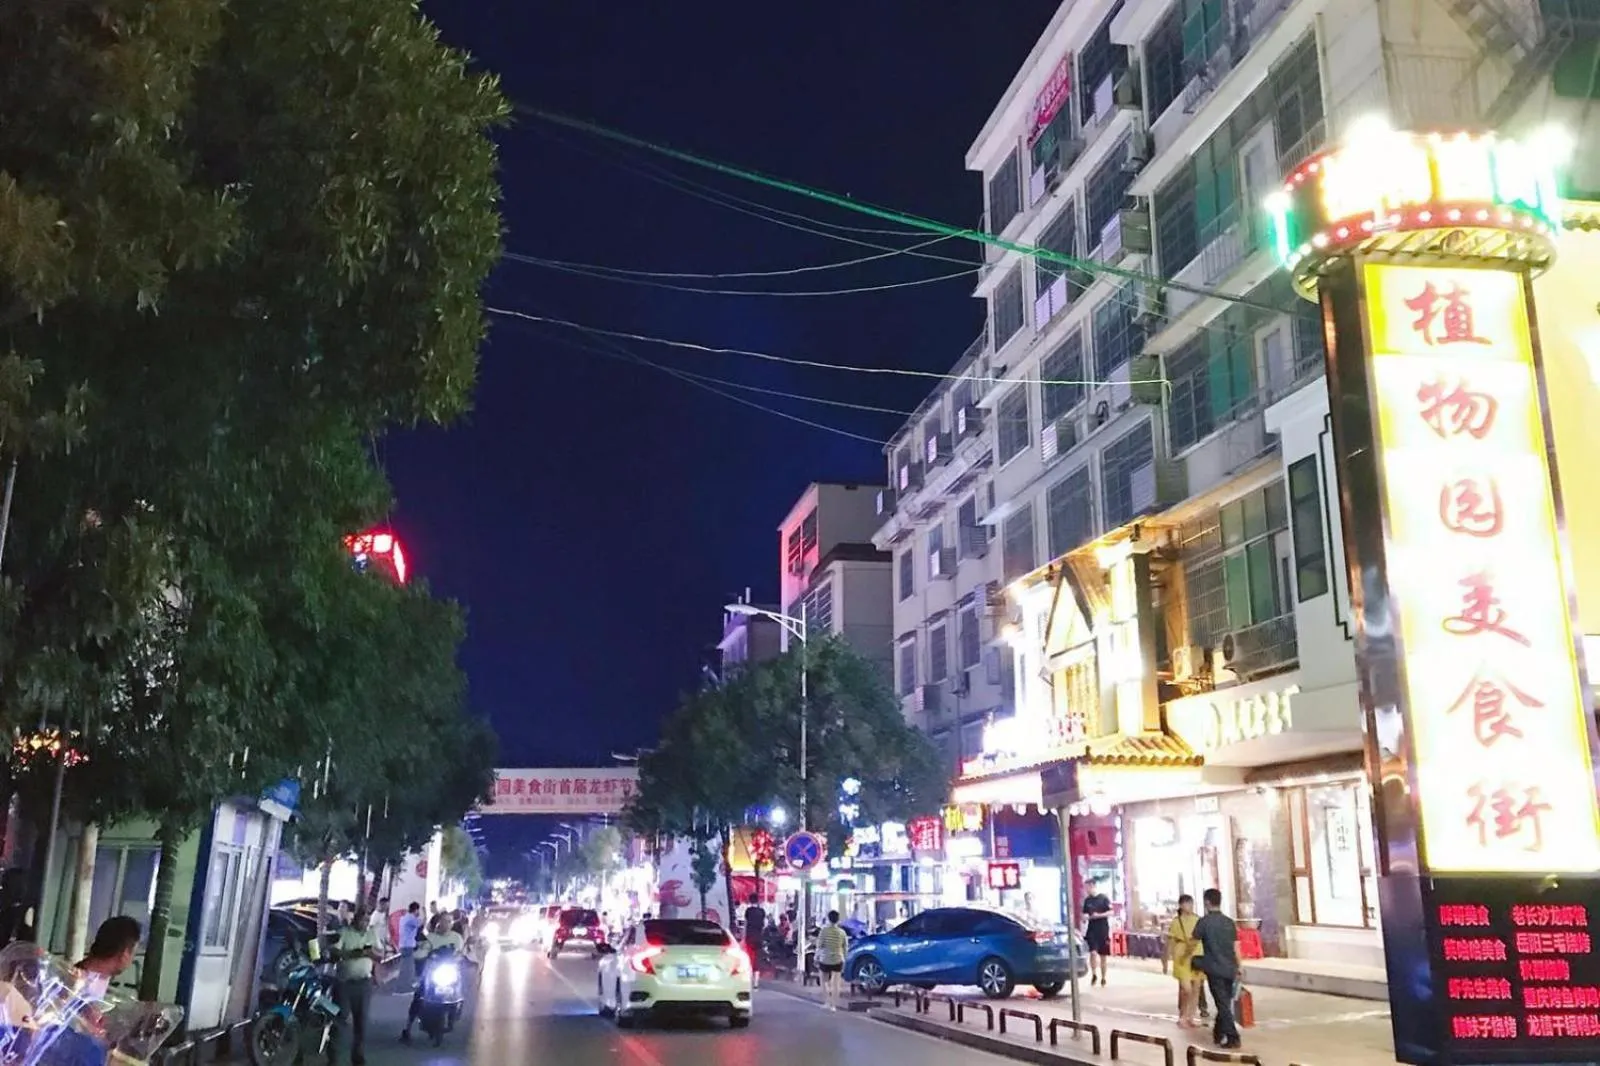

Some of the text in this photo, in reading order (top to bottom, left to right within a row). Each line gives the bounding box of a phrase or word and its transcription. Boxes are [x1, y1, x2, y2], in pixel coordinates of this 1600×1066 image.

[1404, 279, 1553, 852] 植物园美食街
